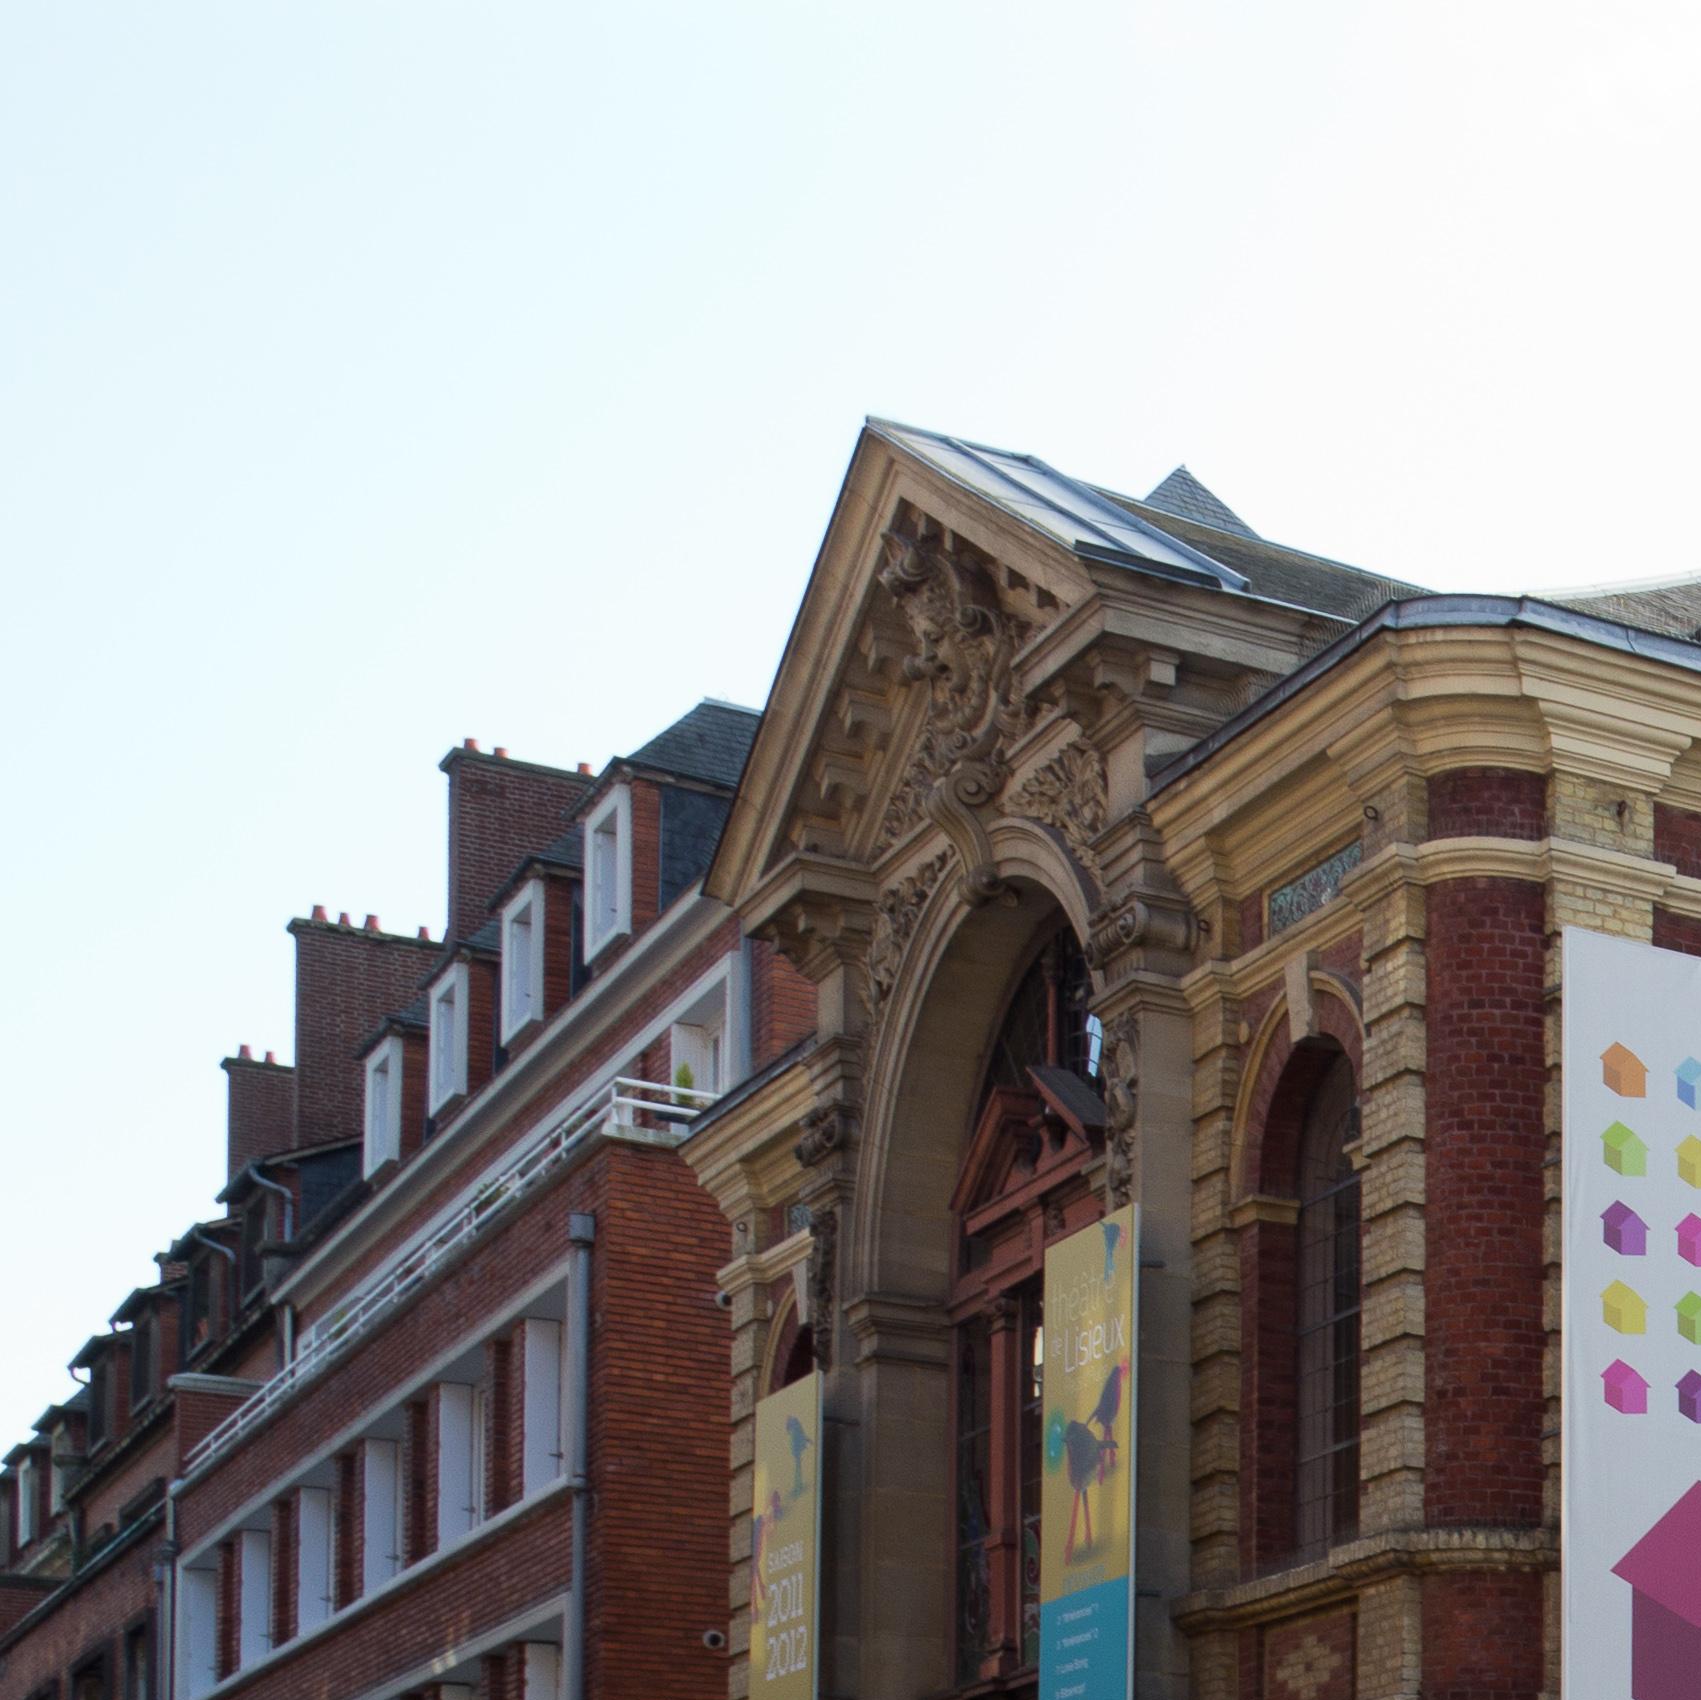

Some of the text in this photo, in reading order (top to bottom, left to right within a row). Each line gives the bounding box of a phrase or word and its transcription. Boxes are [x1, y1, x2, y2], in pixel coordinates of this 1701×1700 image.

[1064, 1313, 1126, 1373] Lisieux
[767, 1540, 804, 1573] SAISON
[767, 1572, 804, 1628] 2011
[766, 1625, 807, 1681] 2012
